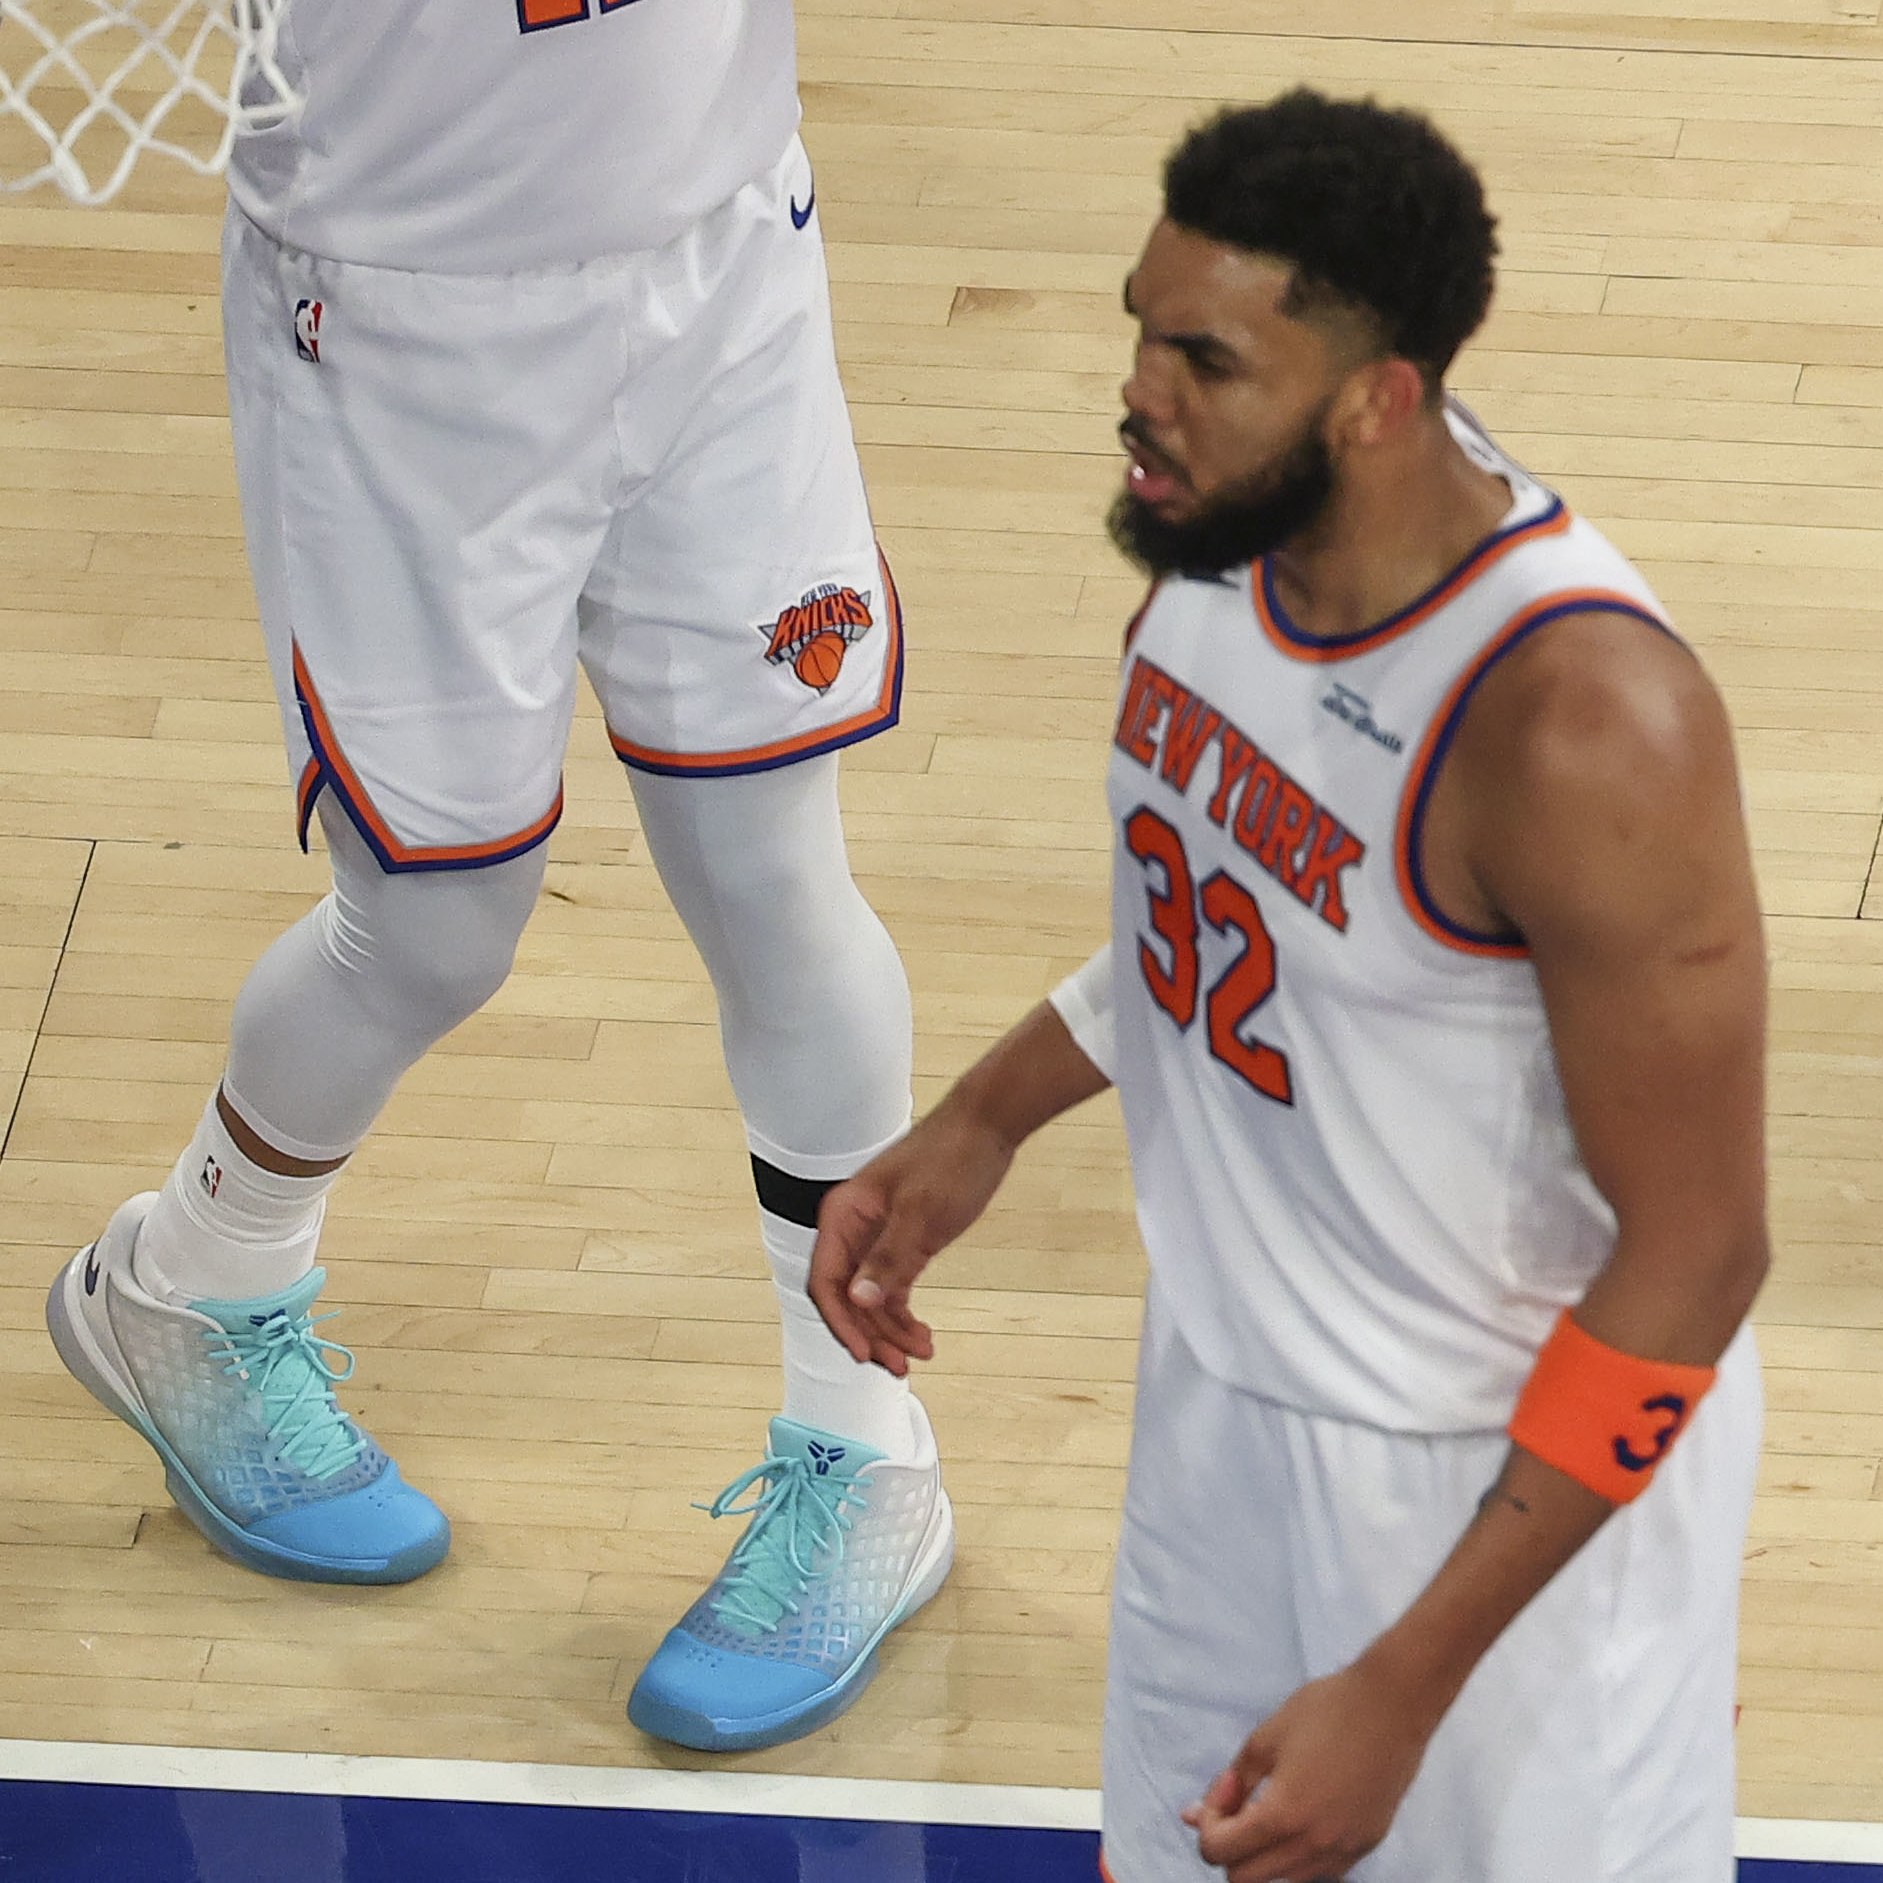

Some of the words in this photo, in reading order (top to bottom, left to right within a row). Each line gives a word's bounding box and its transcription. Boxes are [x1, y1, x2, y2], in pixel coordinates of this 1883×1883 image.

[764, 586, 873, 659] KNICKS
[1208, 719, 1366, 935] YORK
[1123, 803, 1294, 1107] 32
